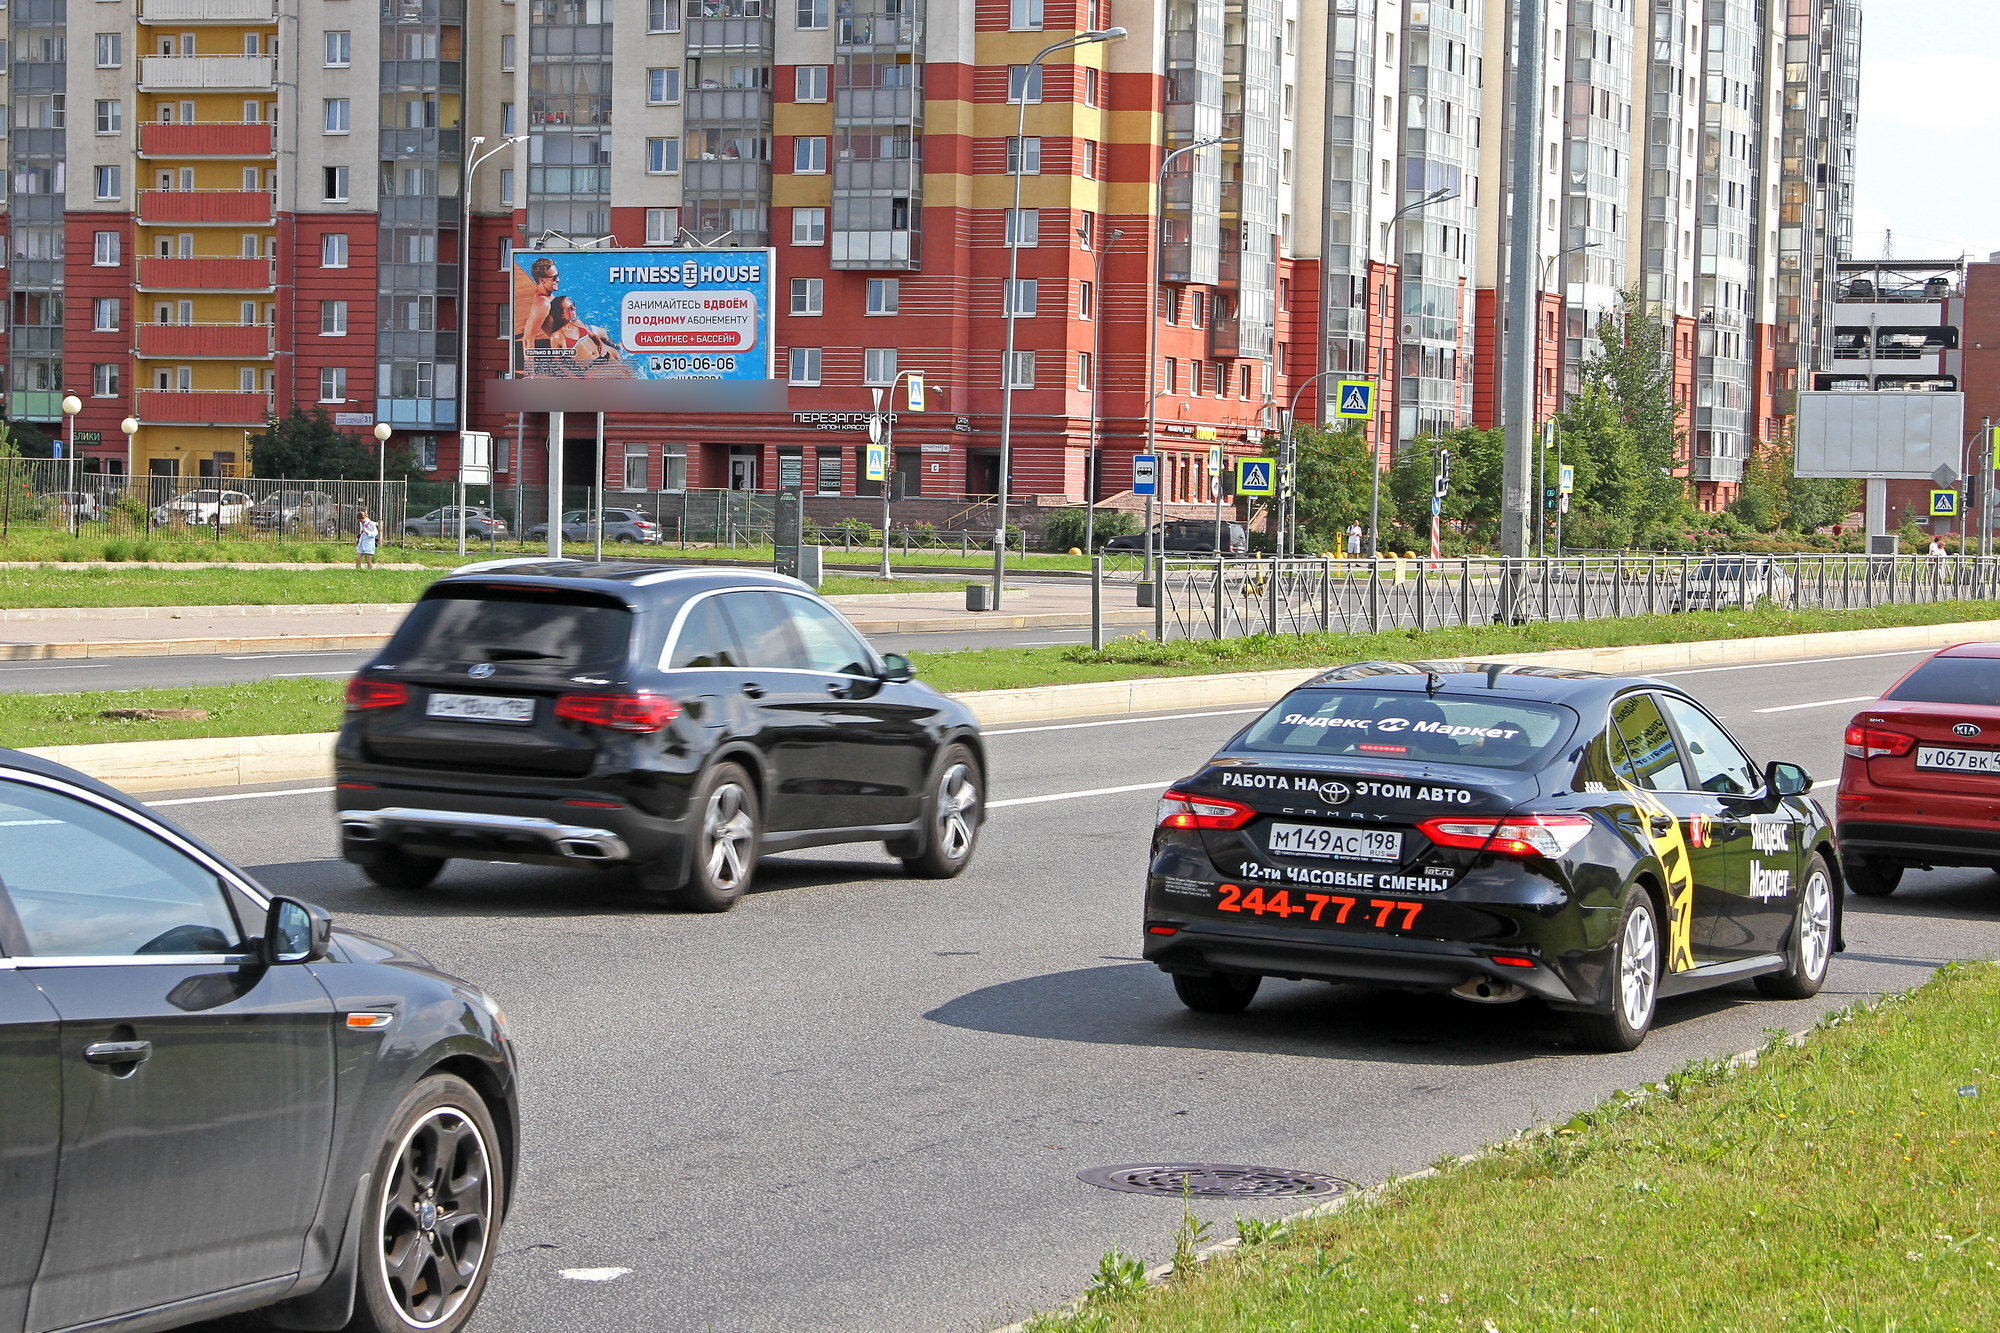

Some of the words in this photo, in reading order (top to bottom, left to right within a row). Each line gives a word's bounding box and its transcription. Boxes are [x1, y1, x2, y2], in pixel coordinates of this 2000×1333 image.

[609, 266, 680, 283] FITNESS
[700, 265, 760, 283] HOUSE
[627, 299, 701, 310] ЗАНИМАЙТЕСЬ
[703, 298, 748, 310] ВДВОЁМ
[627, 316, 641, 325] ПО
[643, 316, 686, 326] ОДНОМУ
[640, 335, 652, 343] НА
[653, 335, 689, 344] ФИТНЕС
[696, 333, 735, 344] БАССЕЙН
[663, 357, 734, 371] 610-06-06
[1281, 714, 1372, 728] Яндекс
[1412, 721, 1519, 739] Маркет
[1957, 725, 1975, 735] KIA
[1222, 773, 1289, 790] РАБОТА
[1295, 778, 1319, 791] НА
[1355, 782, 1410, 799] ЭТОМ
[1417, 787, 1471, 803] АВТО
[1282, 808, 1389, 820] CAMRY
[1275, 828, 1359, 853] М149АС
[1364, 832, 1395, 850] 198
[1751, 814, 1789, 856] Яндекс
[1370, 849, 1385, 857] RUS
[1239, 861, 1281, 880] 12-ти
[1287, 867, 1374, 888] ЧАСОВЫЕ
[1379, 875, 1448, 892] СМЕНЫ
[1750, 860, 1789, 904] Маркет
